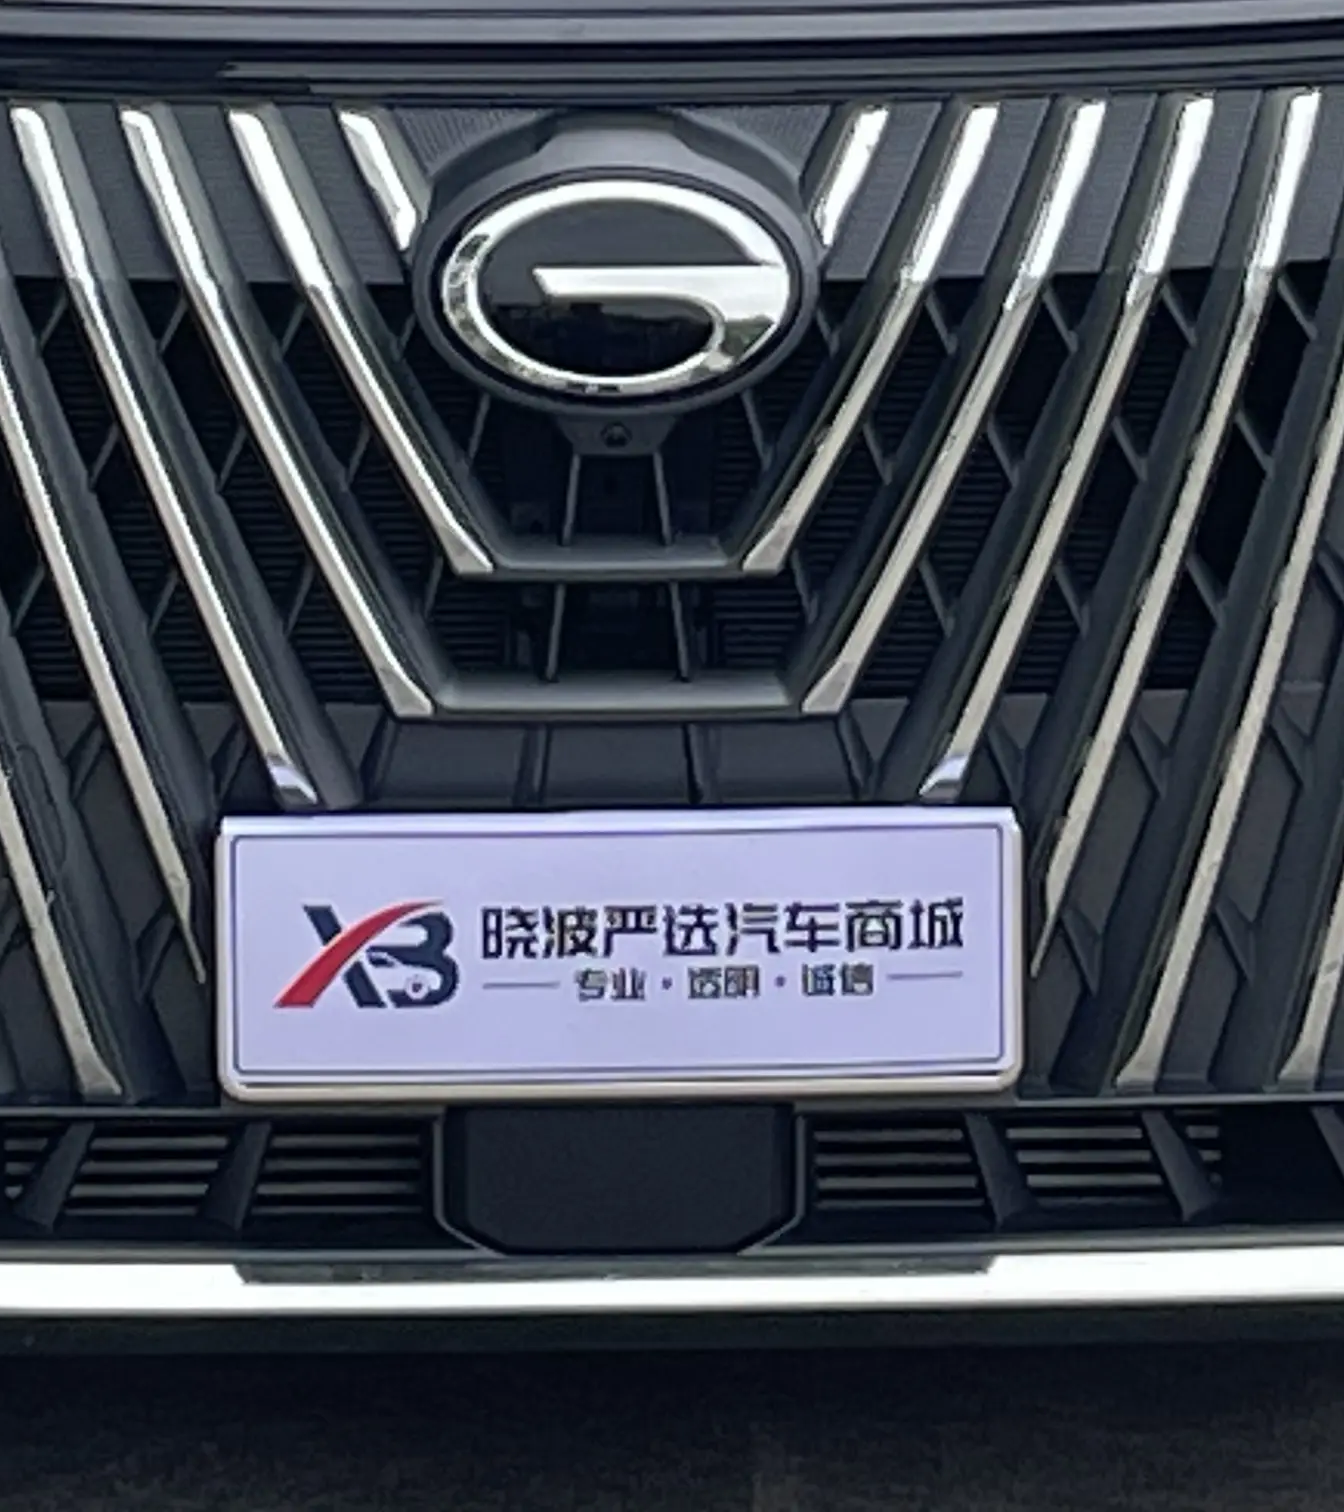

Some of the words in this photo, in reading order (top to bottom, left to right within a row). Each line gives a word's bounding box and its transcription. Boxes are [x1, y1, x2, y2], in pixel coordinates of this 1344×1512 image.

[481, 898, 963, 959] 晓波严选汽车商城
